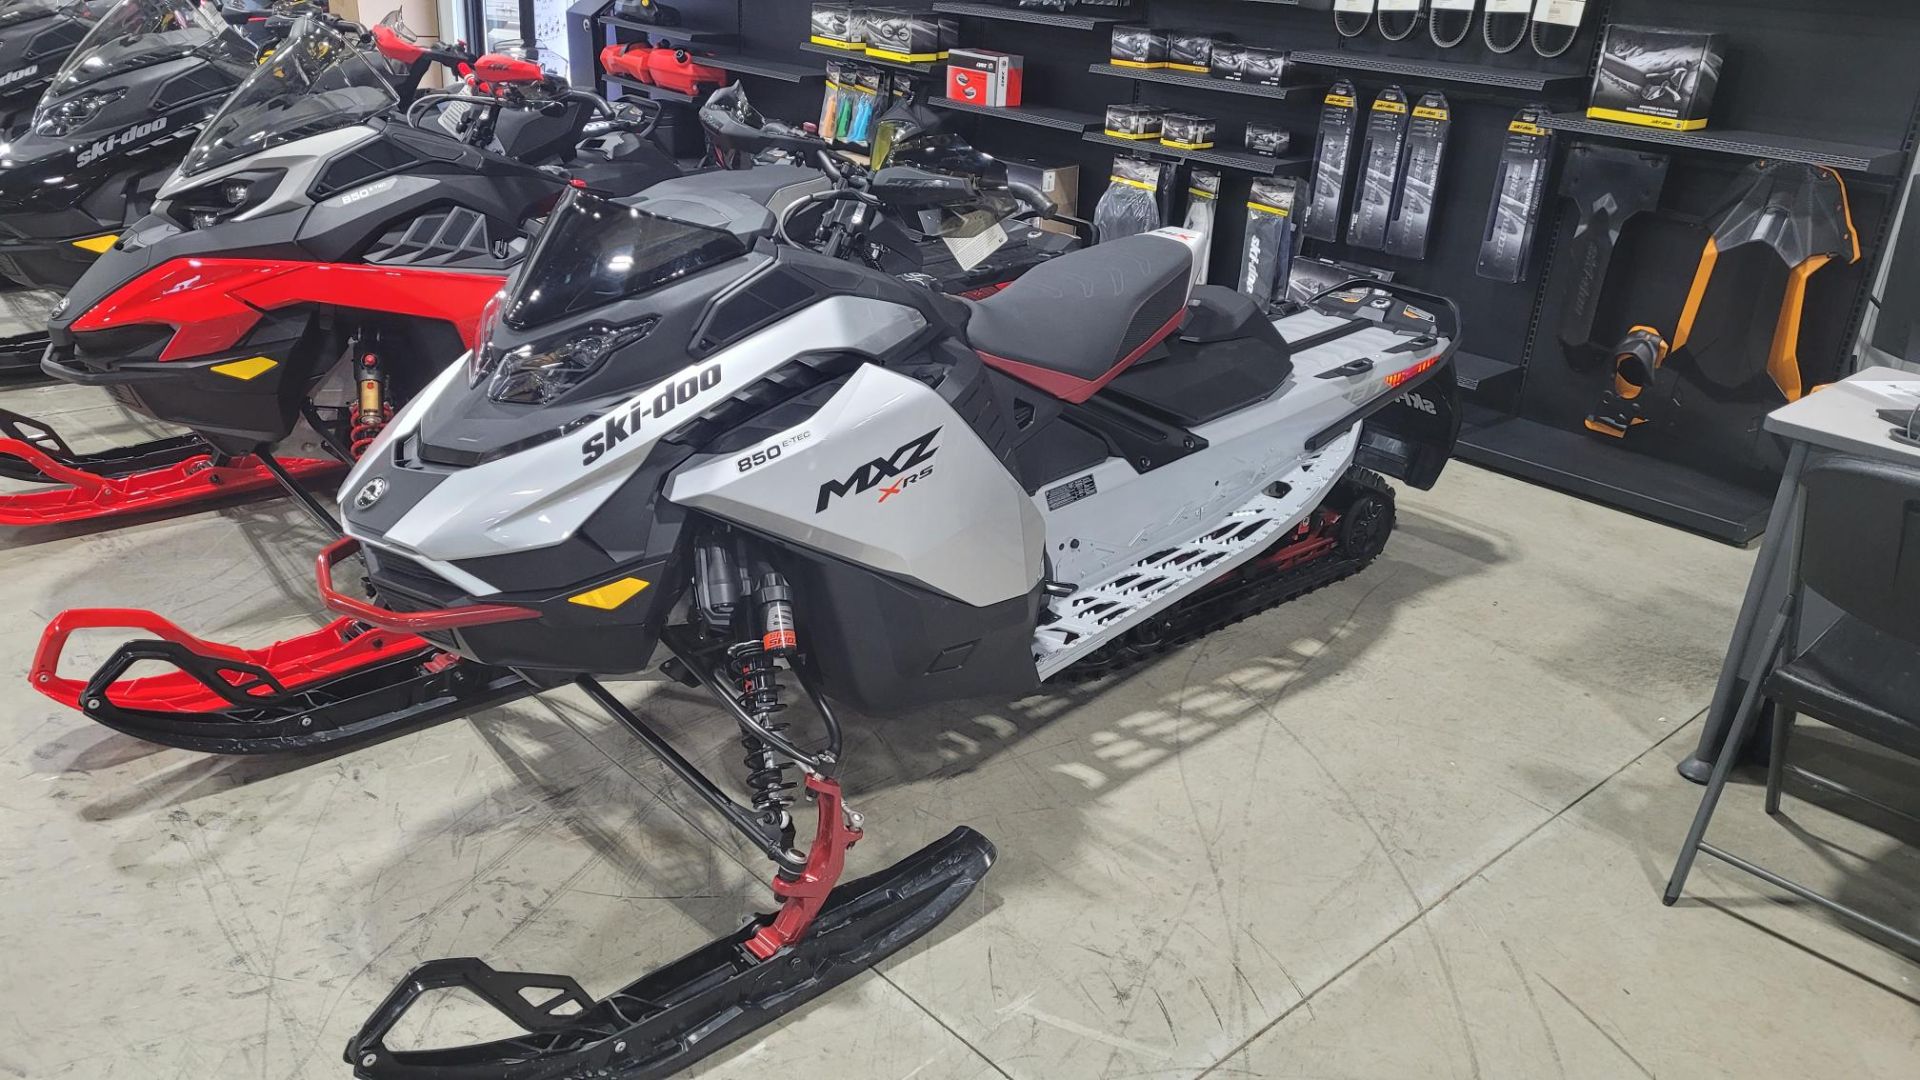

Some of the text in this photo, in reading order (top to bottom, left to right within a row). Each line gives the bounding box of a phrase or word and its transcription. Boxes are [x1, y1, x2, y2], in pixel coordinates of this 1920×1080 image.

[76, 117, 168, 169] ski-doo
[581, 363, 722, 467] ski-doo
[737, 444, 782, 473] 850
[815, 424, 944, 514] MXZ
